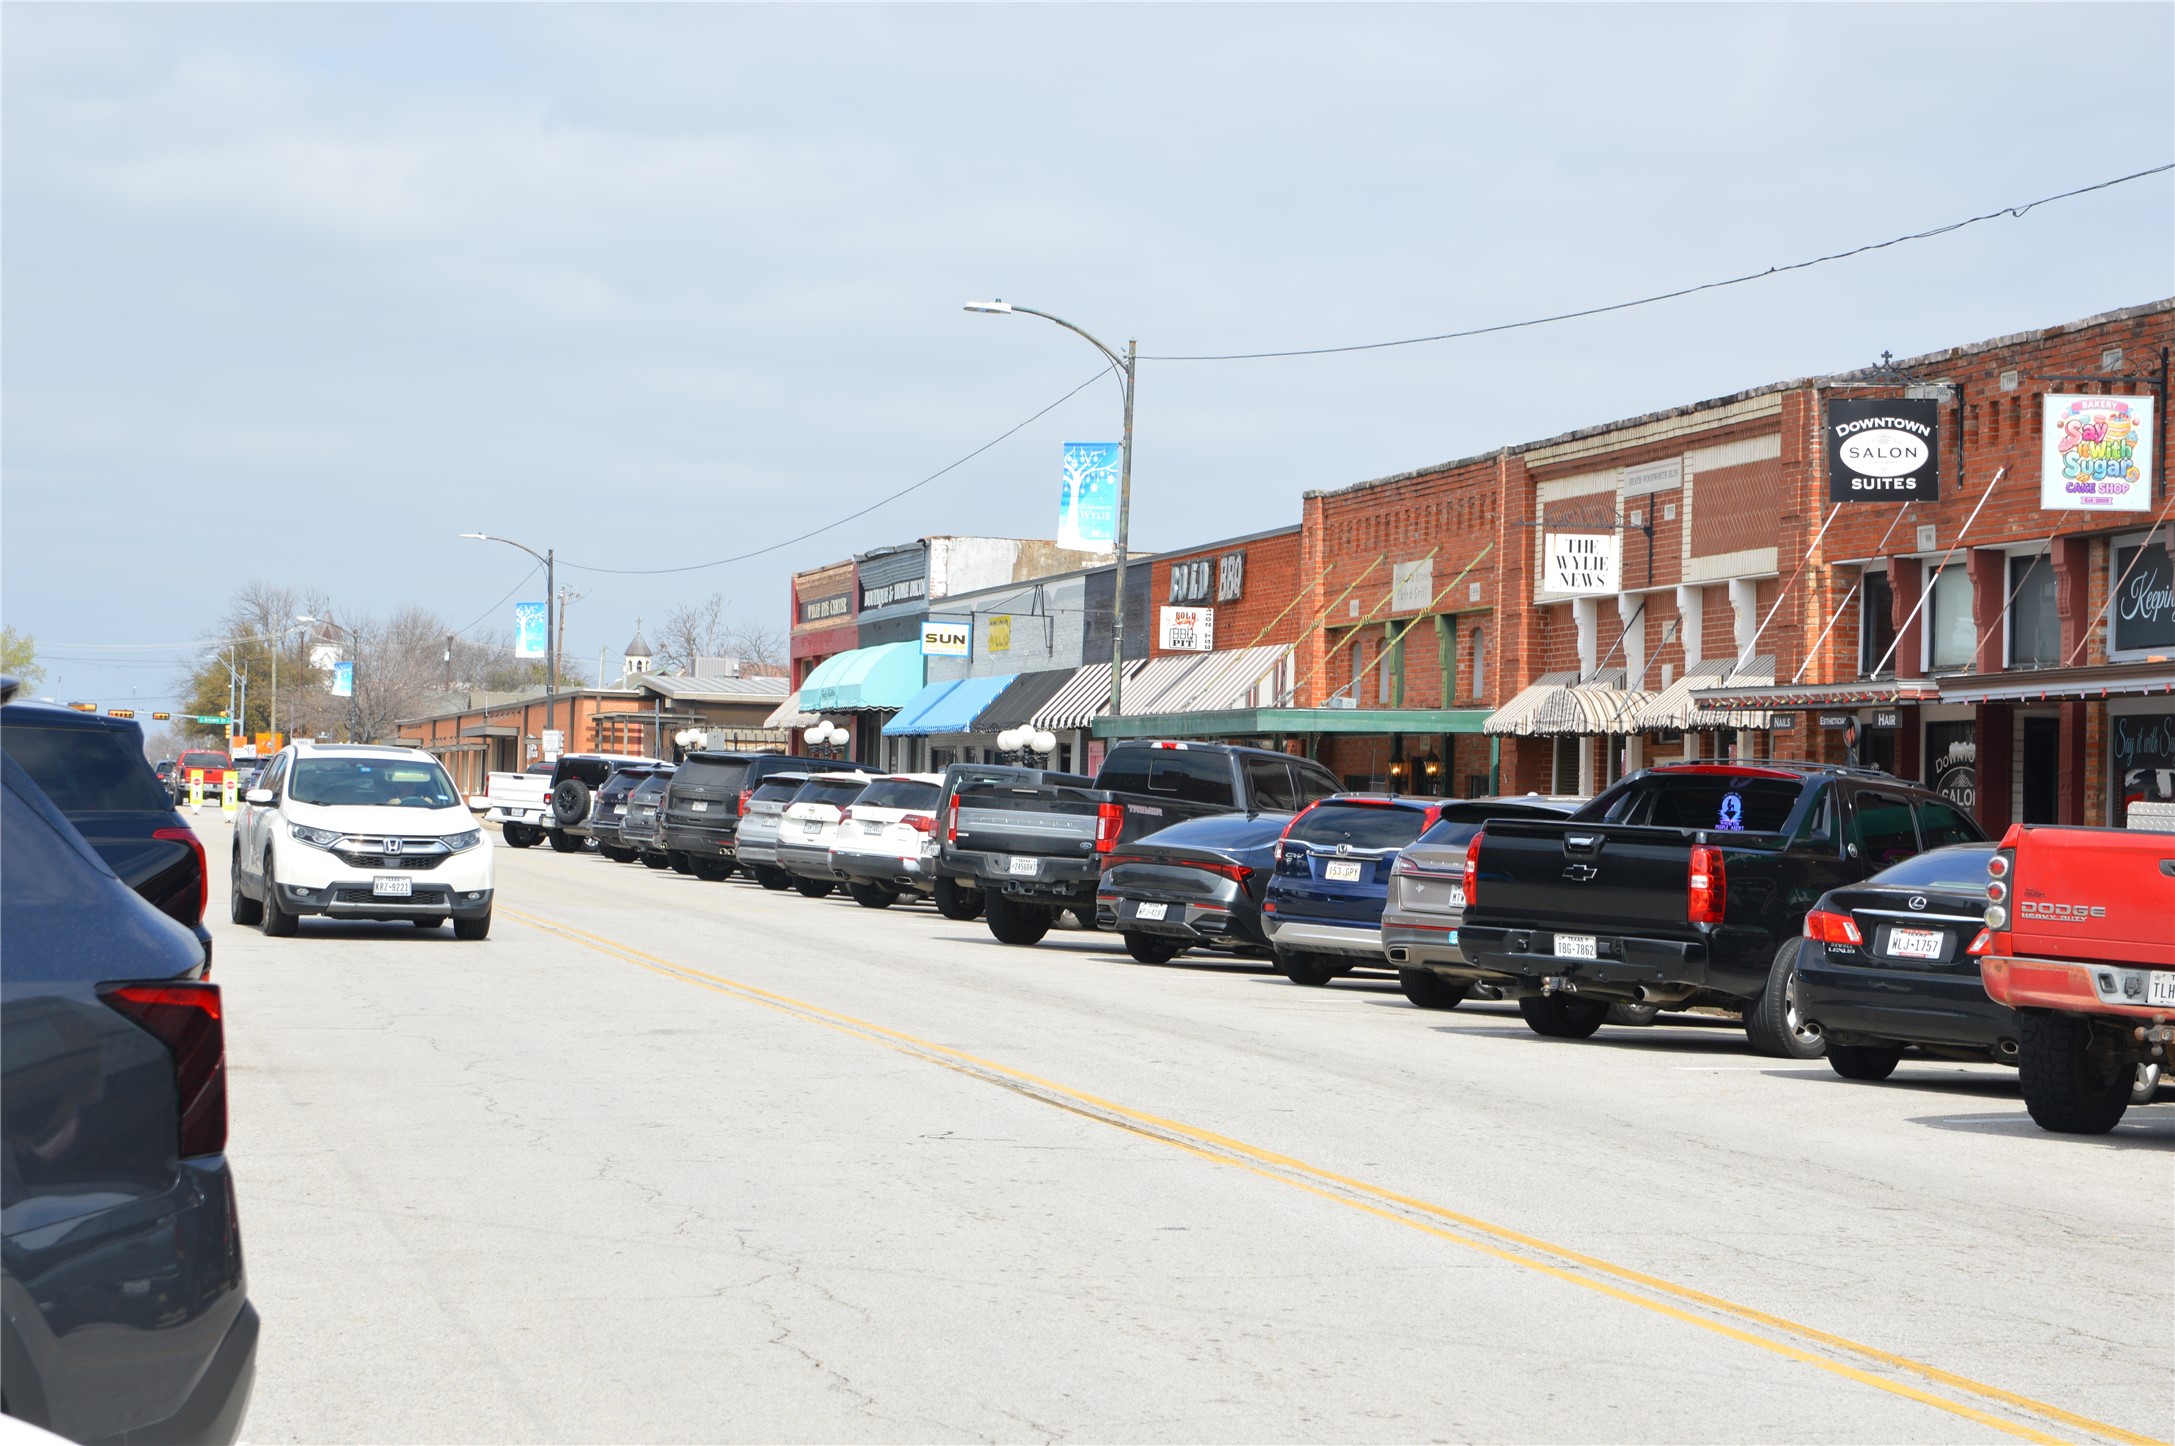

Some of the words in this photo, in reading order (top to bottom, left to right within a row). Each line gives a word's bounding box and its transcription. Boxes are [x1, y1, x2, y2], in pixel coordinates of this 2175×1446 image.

[2081, 400, 2118, 409] BAKERY
[1835, 417, 1931, 438] DOWNTOWN
[2059, 419, 2108, 453] Say
[1849, 446, 1918, 459] SALON
[2062, 450, 2134, 481] Sugar
[1851, 478, 1917, 490] SUITES
[2065, 481, 2097, 494] CAKE
[2098, 482, 2131, 495] SHOP
[1080, 510, 1112, 520] WYLIE
[1565, 539, 1600, 554] THE
[1556, 555, 1609, 571] WYLIE
[1169, 562, 1209, 603] BOLD
[1218, 553, 1242, 602] BBQ
[1560, 572, 1605, 587] NEWS
[1175, 611, 1196, 620] BOLD
[925, 633, 965, 645] SUN
[1172, 639, 1193, 647] PIT
[1774, 716, 1791, 728] NAILS
[1878, 712, 1896, 726] HAIR
[2115, 718, 2134, 767] Say
[1328, 866, 1342, 876] 153
[1345, 868, 1358, 878] GPY
[2021, 901, 2106, 918] DODGE
[2021, 912, 2057, 920] HEAVY
[2060, 915, 2088, 923] DUTY
[1828, 947, 1856, 955] LEXUS
